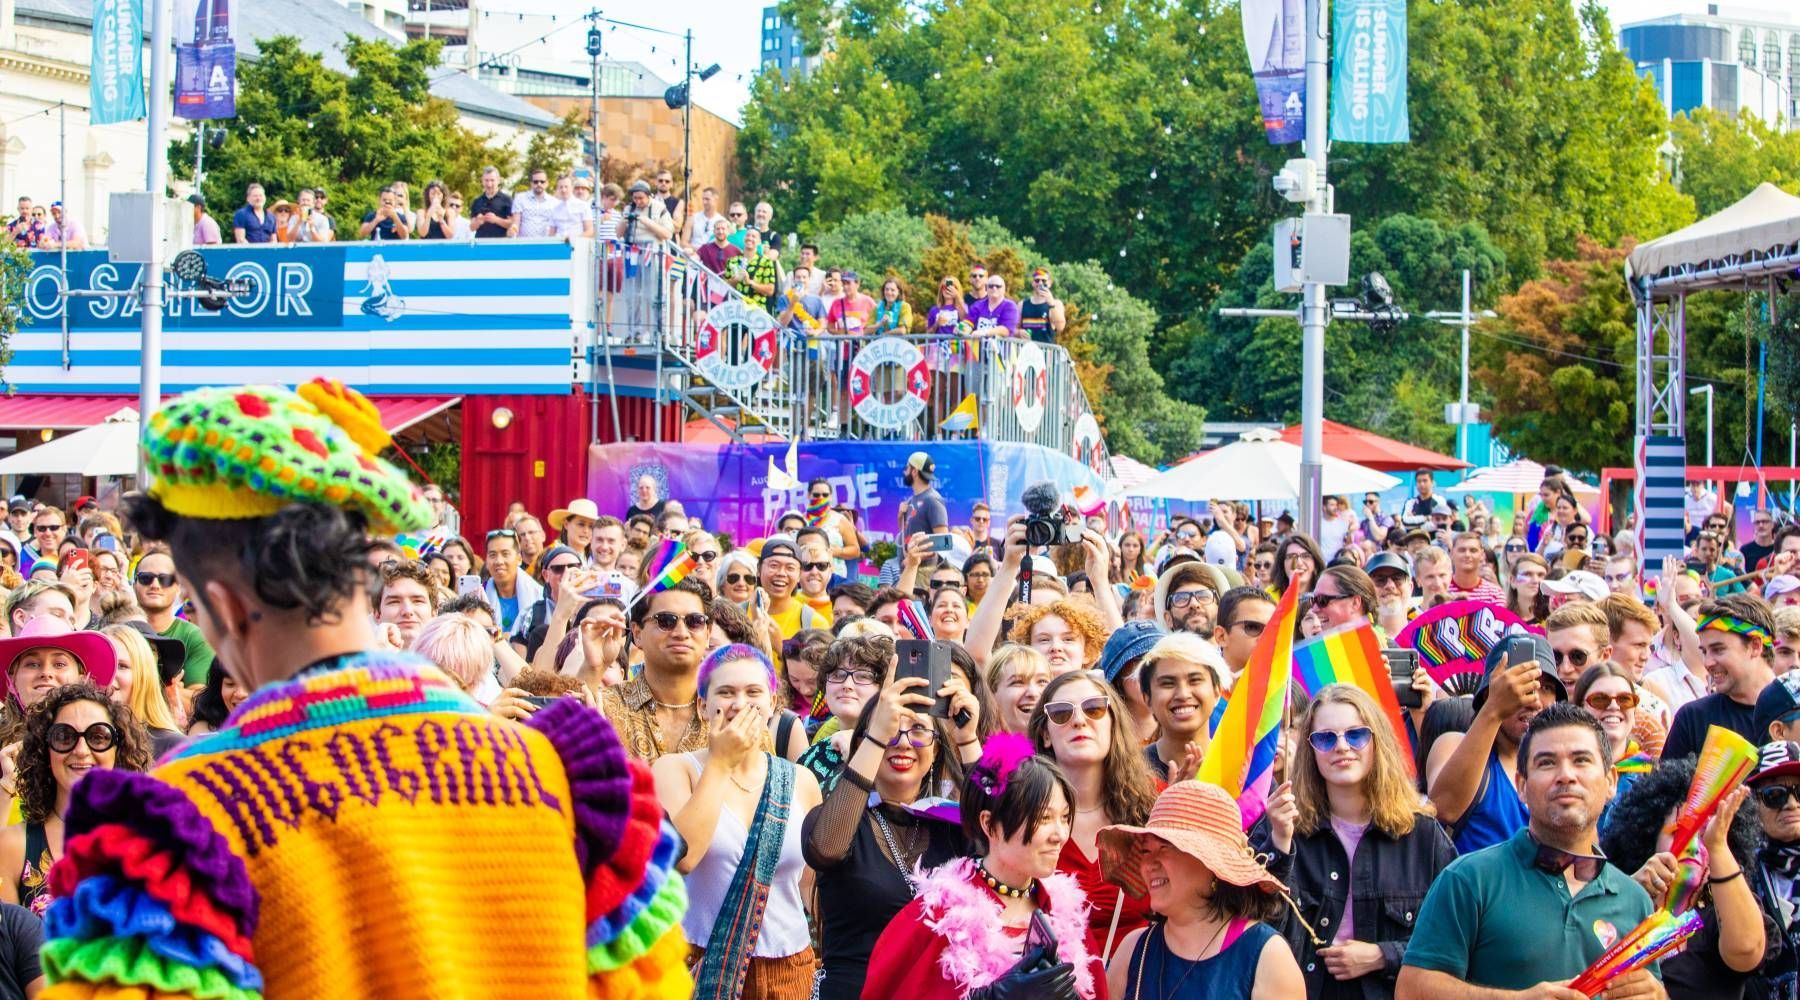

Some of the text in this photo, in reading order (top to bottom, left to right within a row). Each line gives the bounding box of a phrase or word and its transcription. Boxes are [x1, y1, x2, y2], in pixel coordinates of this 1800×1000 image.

[104, 15, 118, 102] CALLING
[117, 0, 133, 75] UMMER
[1352, 9, 1371, 120] IS CALLING
[1372, 9, 1387, 95] SUMMER
[711, 304, 768, 329] HELLO
[858, 343, 917, 370] HELLO
[859, 397, 922, 424] SAILOR
[761, 472, 881, 522] PRDE
